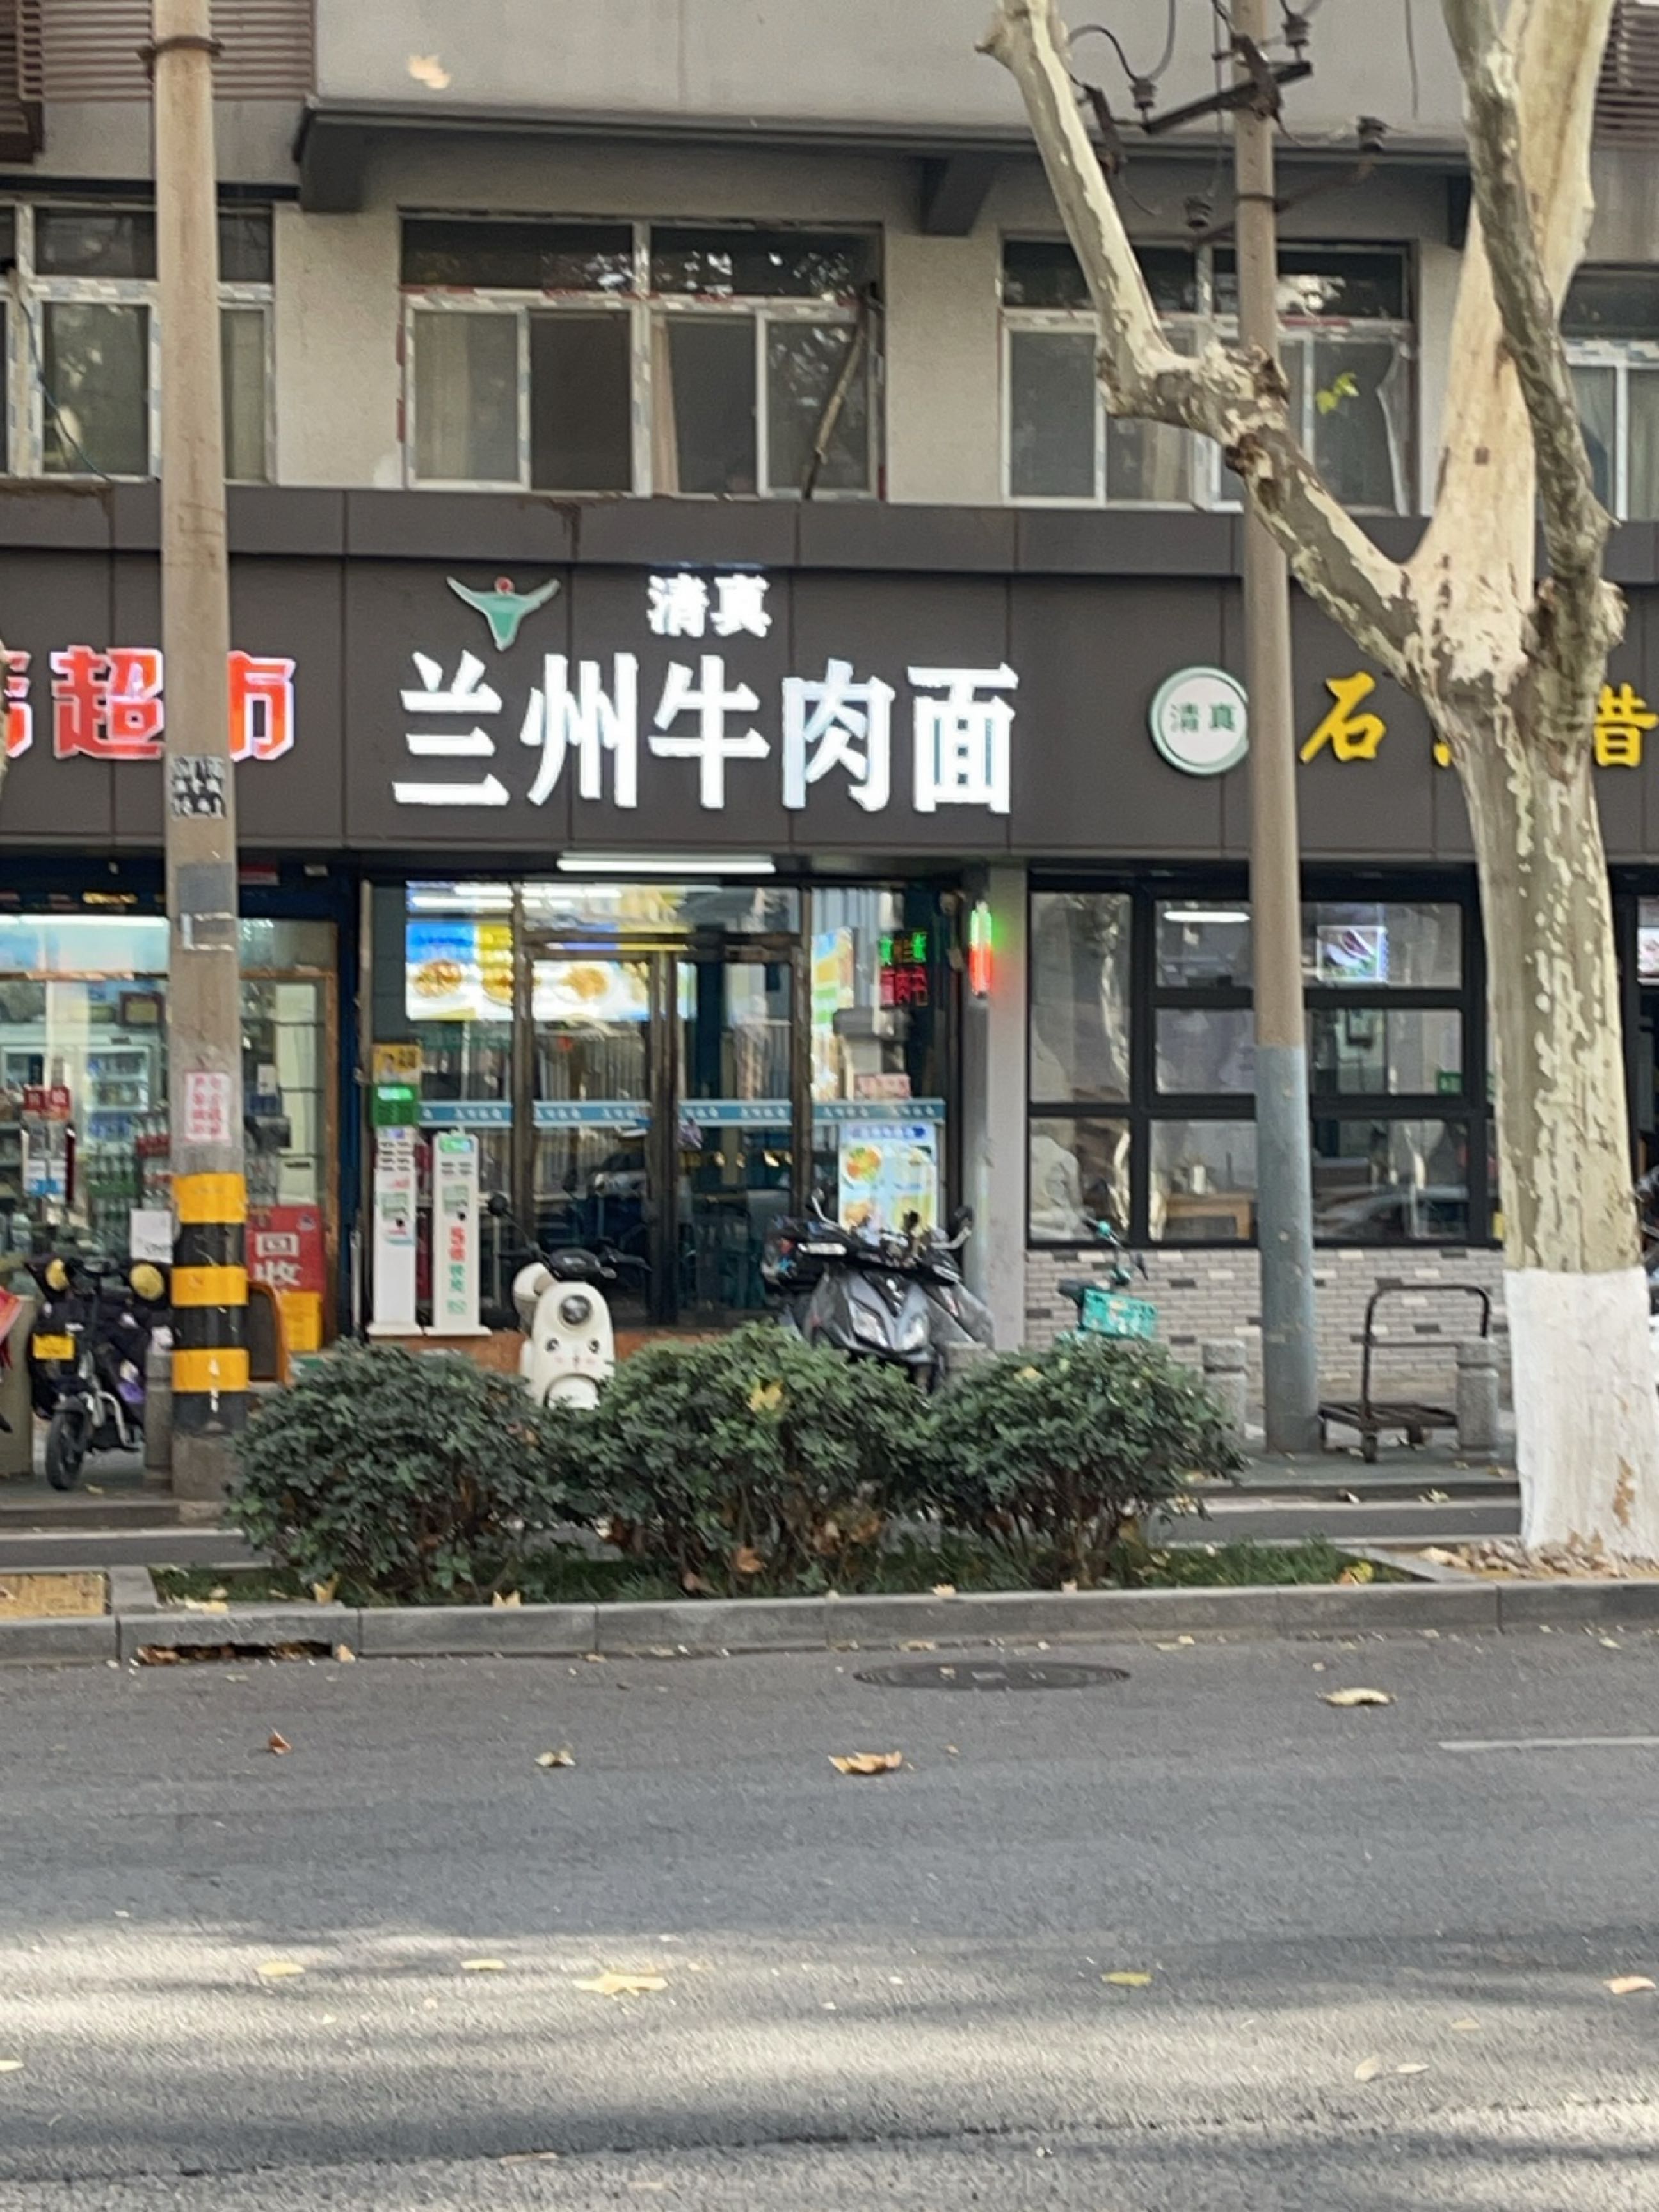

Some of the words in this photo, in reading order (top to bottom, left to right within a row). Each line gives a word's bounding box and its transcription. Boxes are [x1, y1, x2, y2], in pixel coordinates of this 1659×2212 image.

[646, 573, 772, 637] 清真
[3, 645, 296, 762] 超市
[391, 650, 1019, 814] 兰州牛肉面
[1169, 703, 1236, 733] 清真
[1299, 671, 1658, 767] 石昔
